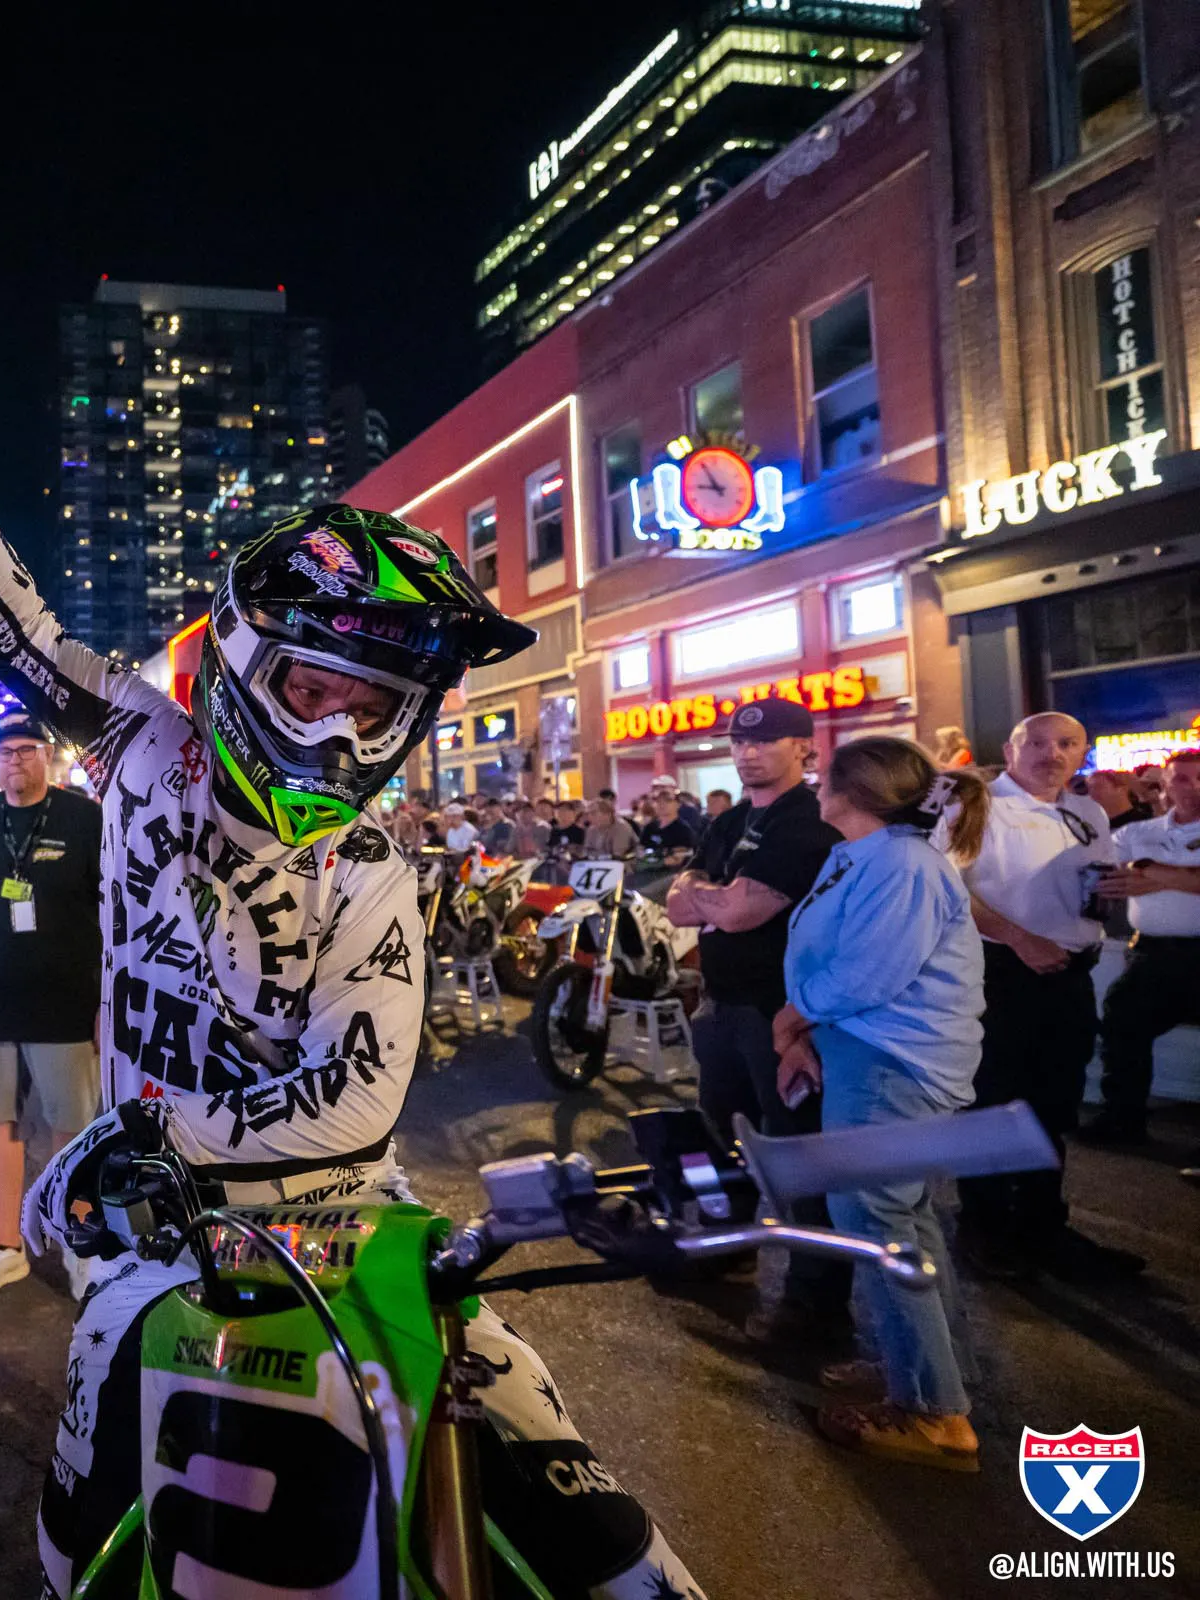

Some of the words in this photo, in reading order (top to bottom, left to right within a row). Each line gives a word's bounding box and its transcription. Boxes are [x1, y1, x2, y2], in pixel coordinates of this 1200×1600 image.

[1112, 255, 1135, 325] HOT
[961, 429, 1167, 539] LUCKY
[393, 540, 432, 560] BELL
[679, 528, 763, 550] BOOTS
[604, 694, 717, 742] BOOTS
[576, 867, 614, 890] 47
[236, 1209, 364, 1229] ENTHAL
[546, 1459, 623, 1496] CAS
